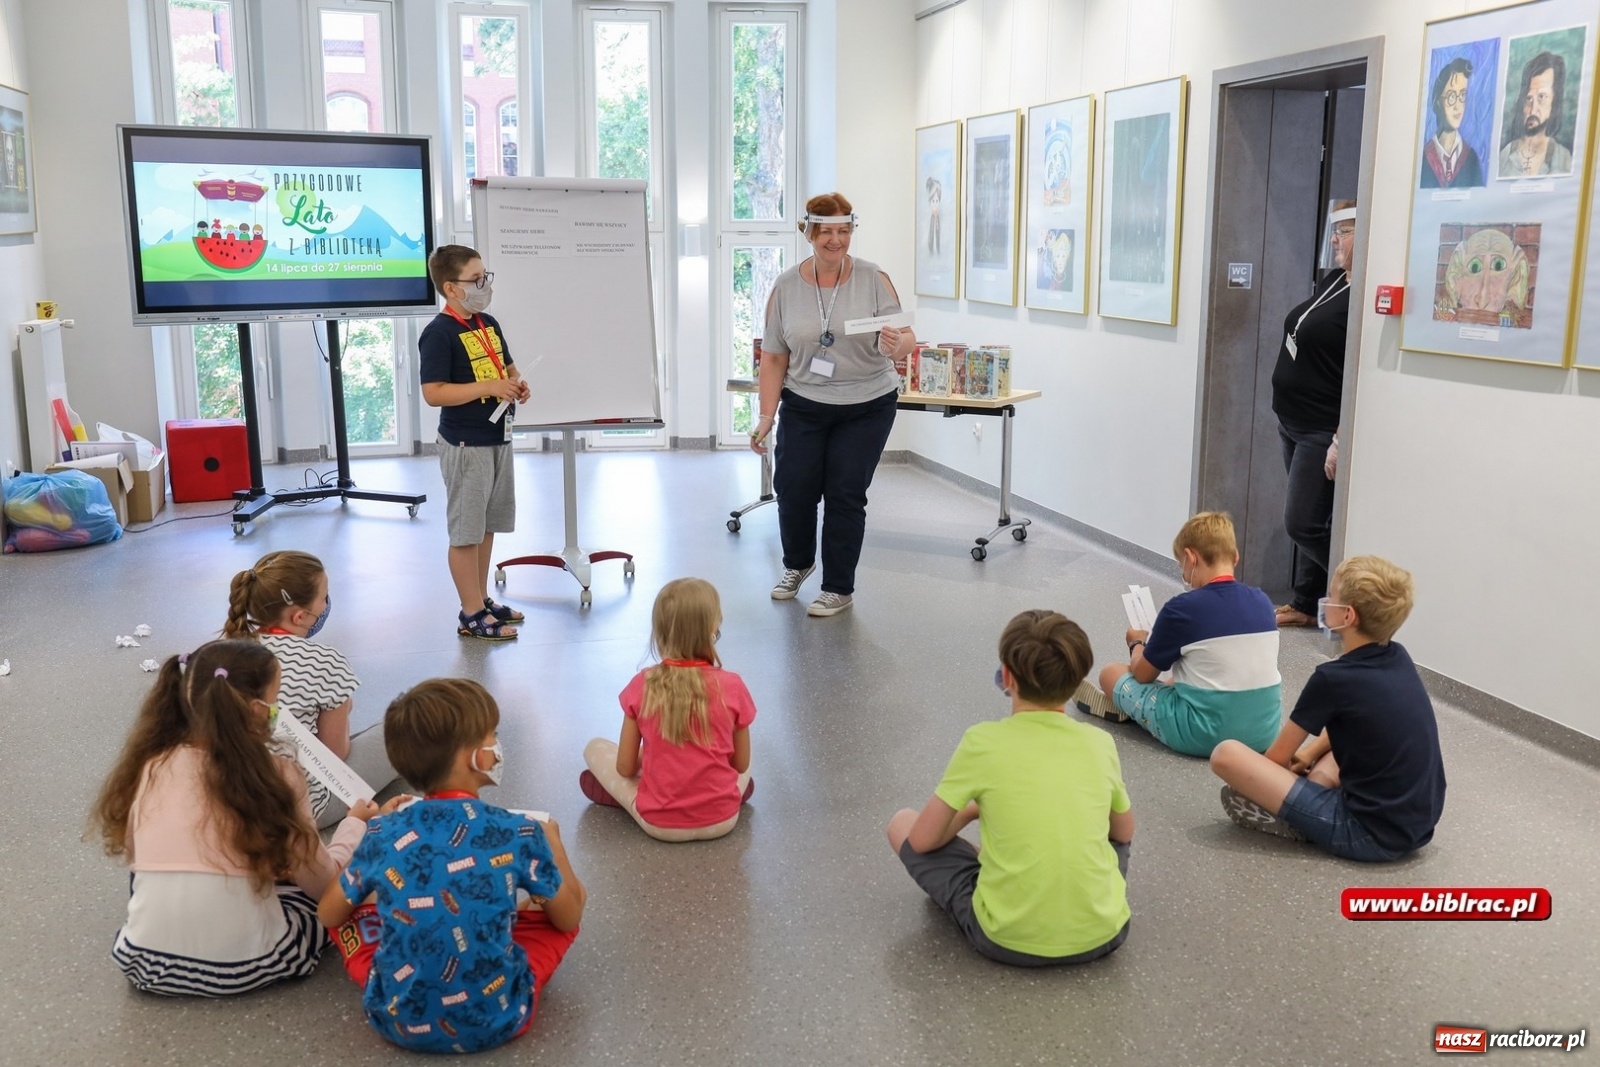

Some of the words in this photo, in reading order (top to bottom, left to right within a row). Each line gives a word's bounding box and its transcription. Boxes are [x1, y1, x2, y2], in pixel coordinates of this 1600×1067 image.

[274, 173, 362, 192] PRZYGODOWE
[282, 194, 338, 234] Lato
[289, 238, 295, 255] Z
[305, 238, 382, 257] BIBLIOTEKĄ
[266, 263, 278, 273] 14
[280, 262, 307, 275] lipca
[310, 262, 325, 272] do
[328, 262, 340, 272] 27
[343, 261, 383, 274] sierpnia
[1231, 266, 1248, 275] WC
[311, 756, 321, 768] PO
[319, 764, 352, 799] ZAJĘCIACH
[393, 831, 419, 851] MARVEL
[446, 856, 477, 873] MARVEL
[489, 852, 514, 868] HULK
[384, 867, 406, 890] HULK
[408, 896, 434, 909] MARVEL
[482, 974, 507, 996] HULK
